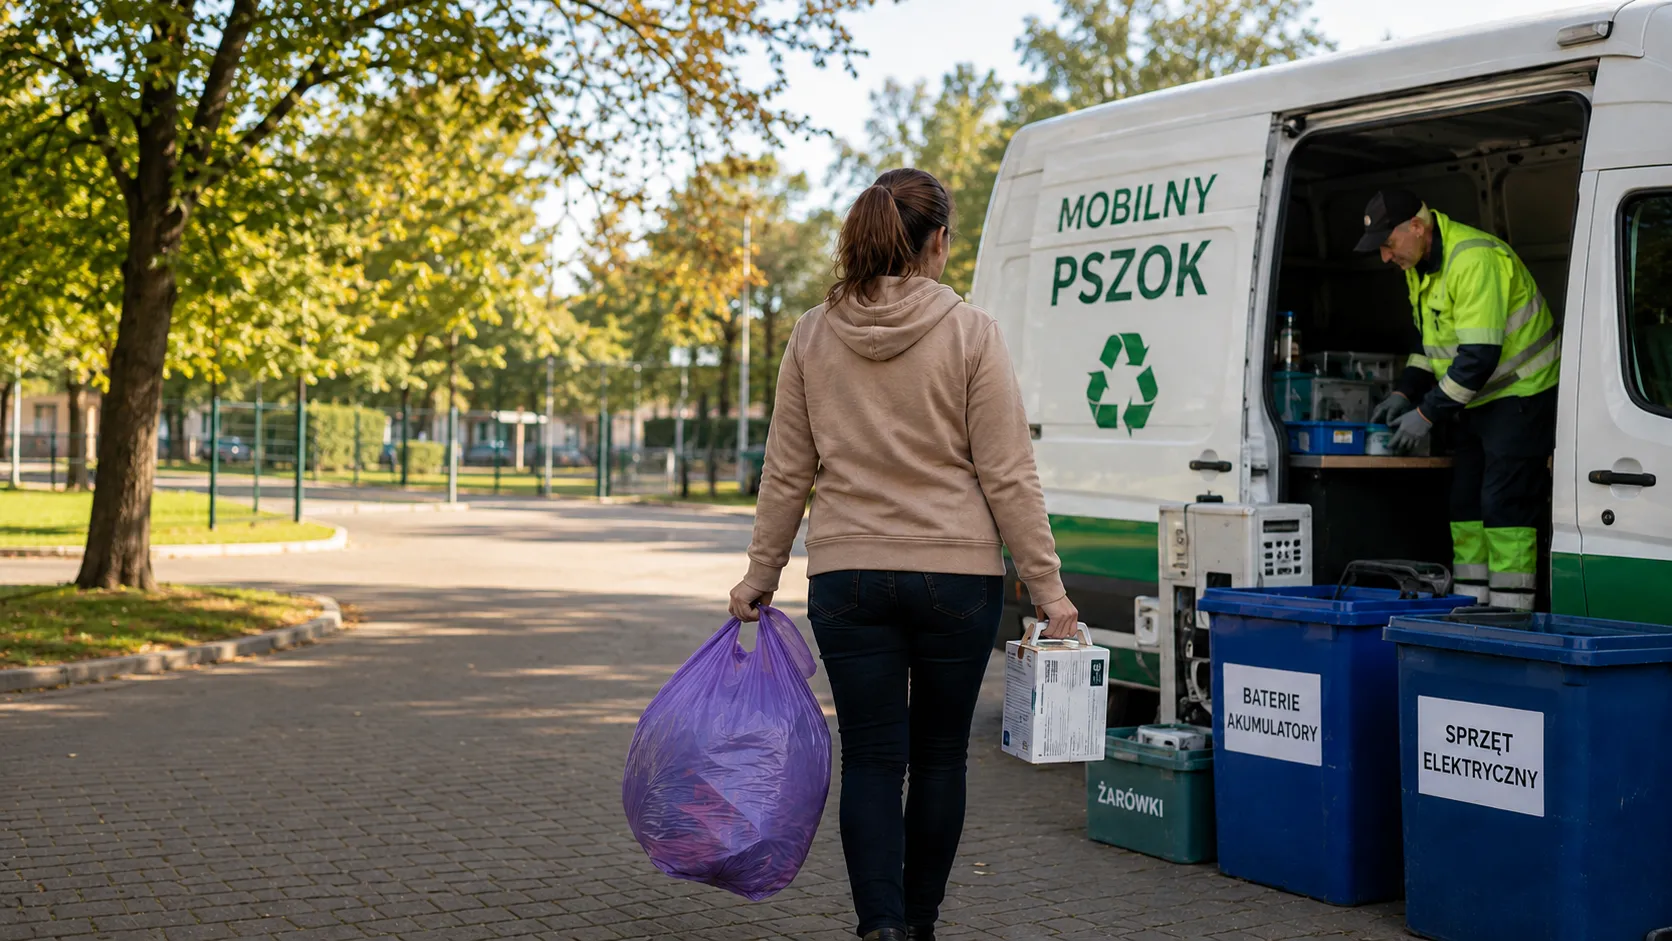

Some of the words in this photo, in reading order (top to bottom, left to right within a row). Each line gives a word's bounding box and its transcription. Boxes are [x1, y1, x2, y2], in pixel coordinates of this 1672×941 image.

[1058, 173, 1218, 233] MOBILNY
[1051, 239, 1212, 307] PSZOK
[1243, 687, 1300, 712] BATERIE
[1227, 712, 1318, 742] AKUMULATORY
[1445, 724, 1514, 756] SPRZĘT
[1423, 751, 1538, 789] ELEKTRYCZNY
[1097, 780, 1164, 818] ŻARÓWKI
